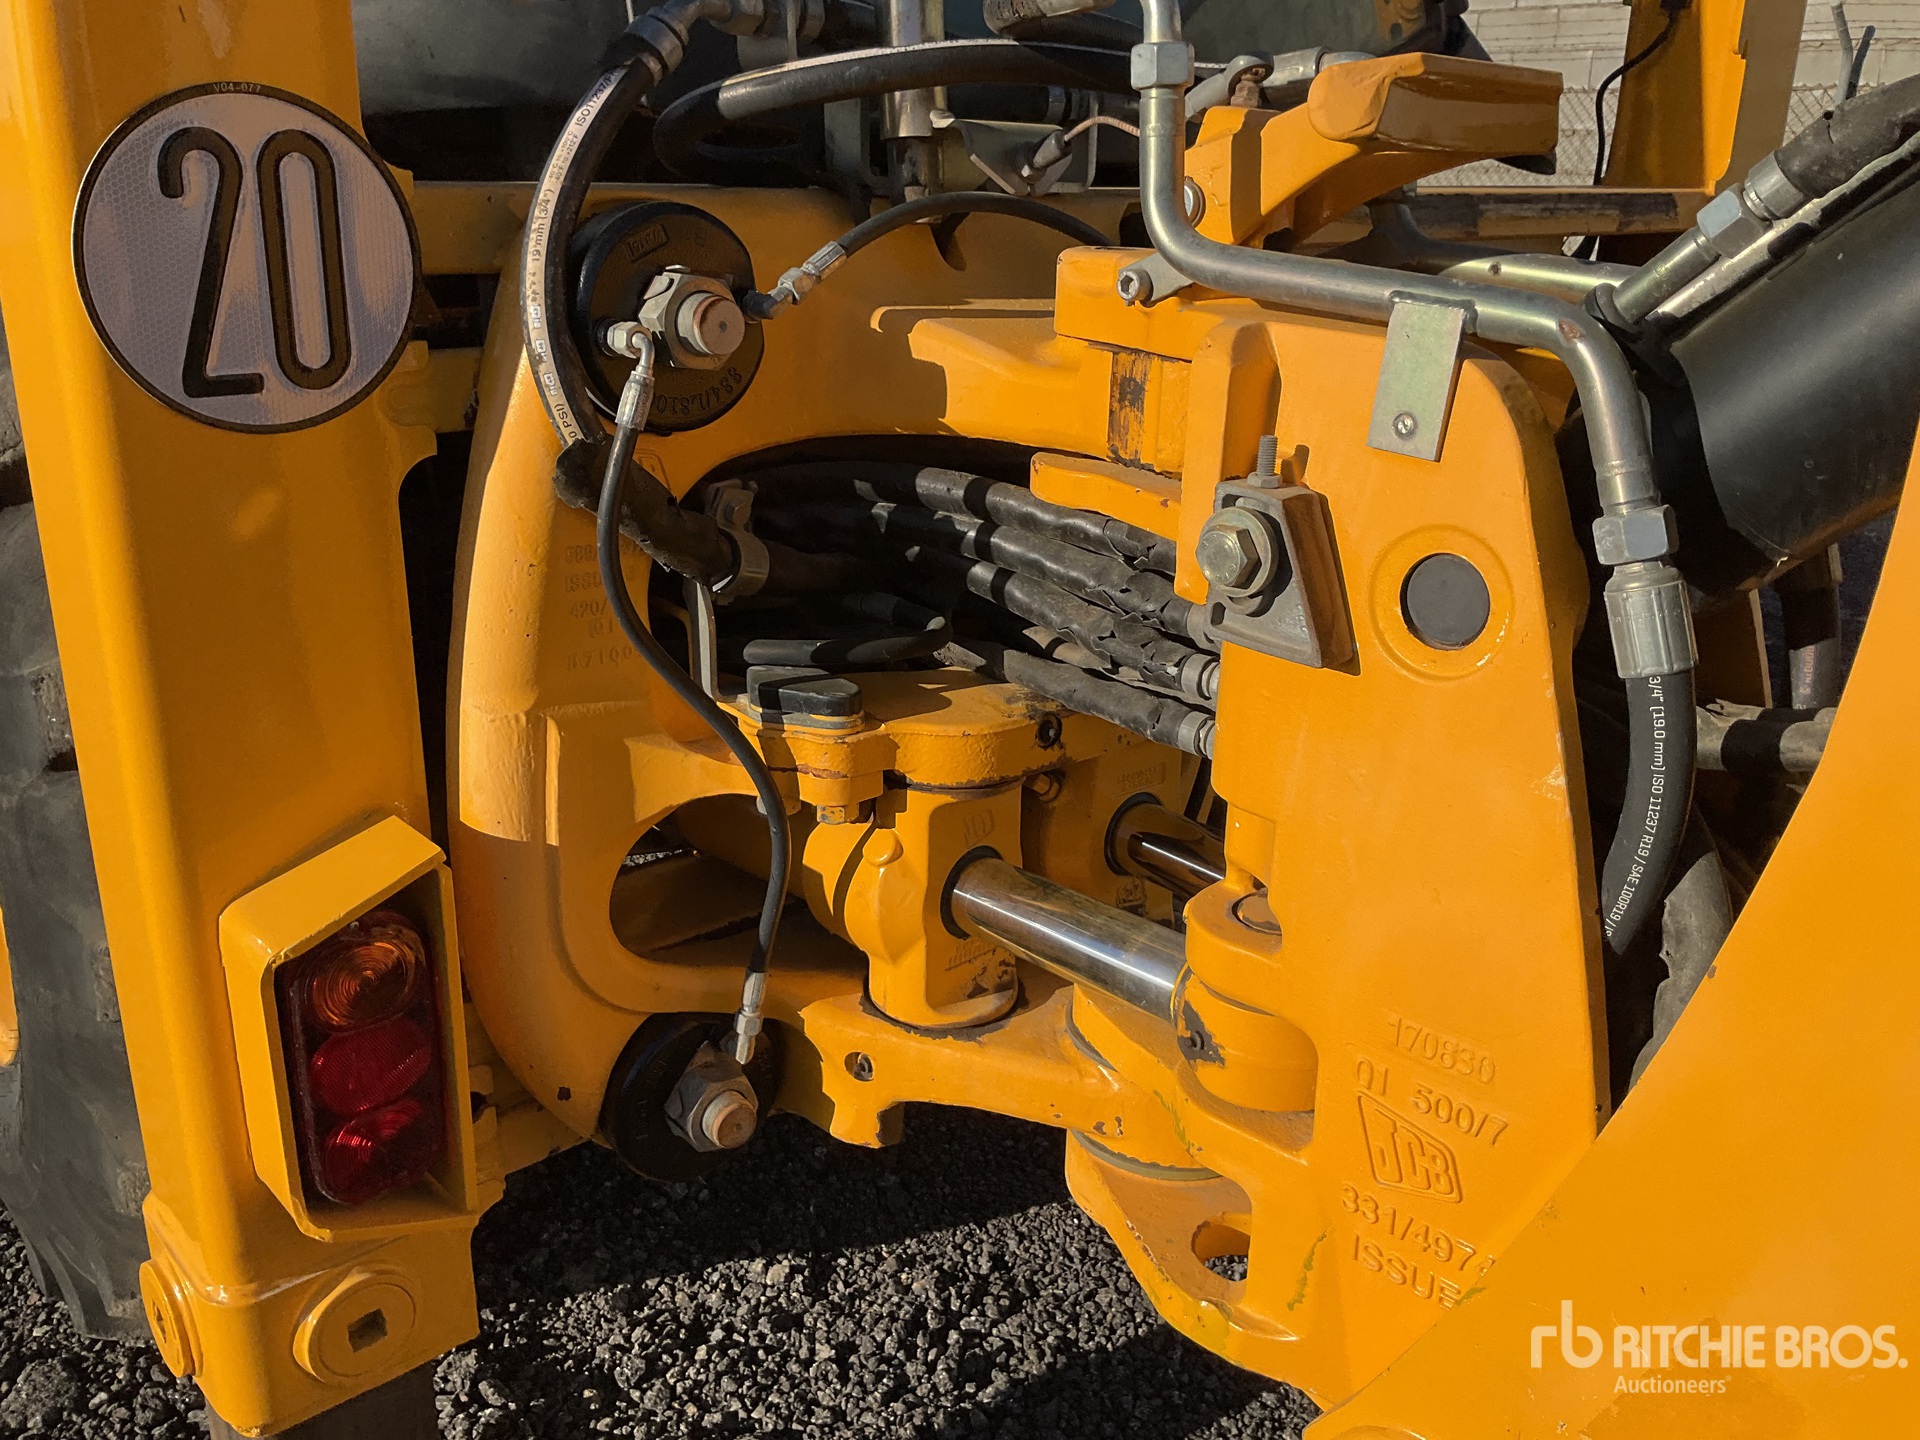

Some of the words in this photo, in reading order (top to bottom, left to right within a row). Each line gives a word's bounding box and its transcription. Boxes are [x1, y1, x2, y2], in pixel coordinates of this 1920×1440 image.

[213, 82, 261, 93] V04-077
[536, 223, 545, 246] mm
[157, 126, 352, 398] 20
[532, 249, 543, 262] 19
[554, 403, 572, 428] PSI)
[1648, 676, 1664, 702] 3/4"
[1652, 774, 1665, 794] ISO
[1645, 796, 1662, 833] 11237
[1638, 834, 1654, 857] R19
[1627, 863, 1644, 885] SAE
[1610, 884, 1635, 921] 100R19
[1413, 1082, 1508, 1146] 500/7
[1368, 1102, 1459, 1199] JCB
